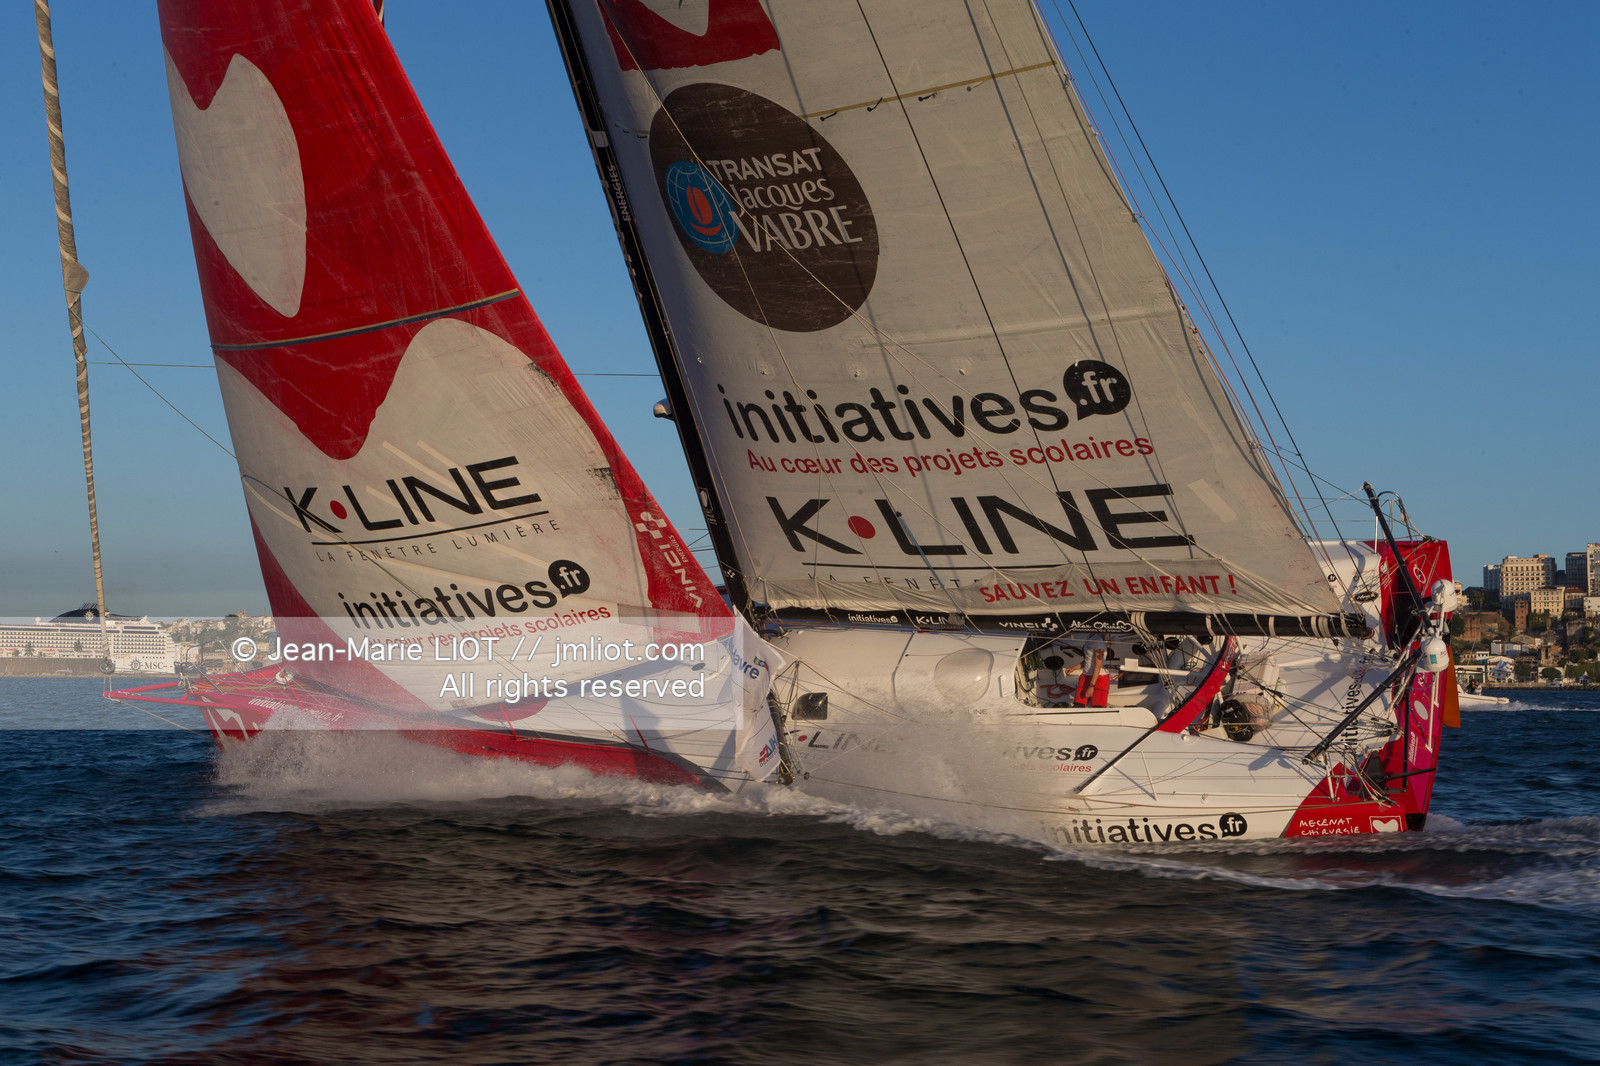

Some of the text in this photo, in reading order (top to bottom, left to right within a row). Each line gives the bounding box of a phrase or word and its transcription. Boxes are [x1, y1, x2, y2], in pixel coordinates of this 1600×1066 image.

[706, 147, 822, 183] TRANSAT
[729, 178, 835, 217] Jacques
[728, 205, 863, 253] VABRE
[747, 436, 1155, 477] Au cœur des projets scolaires
[316, 519, 561, 563] LA FENÊTRE LUMIÈRE
[659, 543, 703, 608] VINCI
[979, 575, 1076, 602] SAUVEZ
[1083, 576, 1122, 597] UN
[1127, 574, 1221, 596] ENFANT
[524, 606, 611, 633] scolaires
[999, 621, 1039, 629] VINCI
[144, 661, 164, 670] MSC
